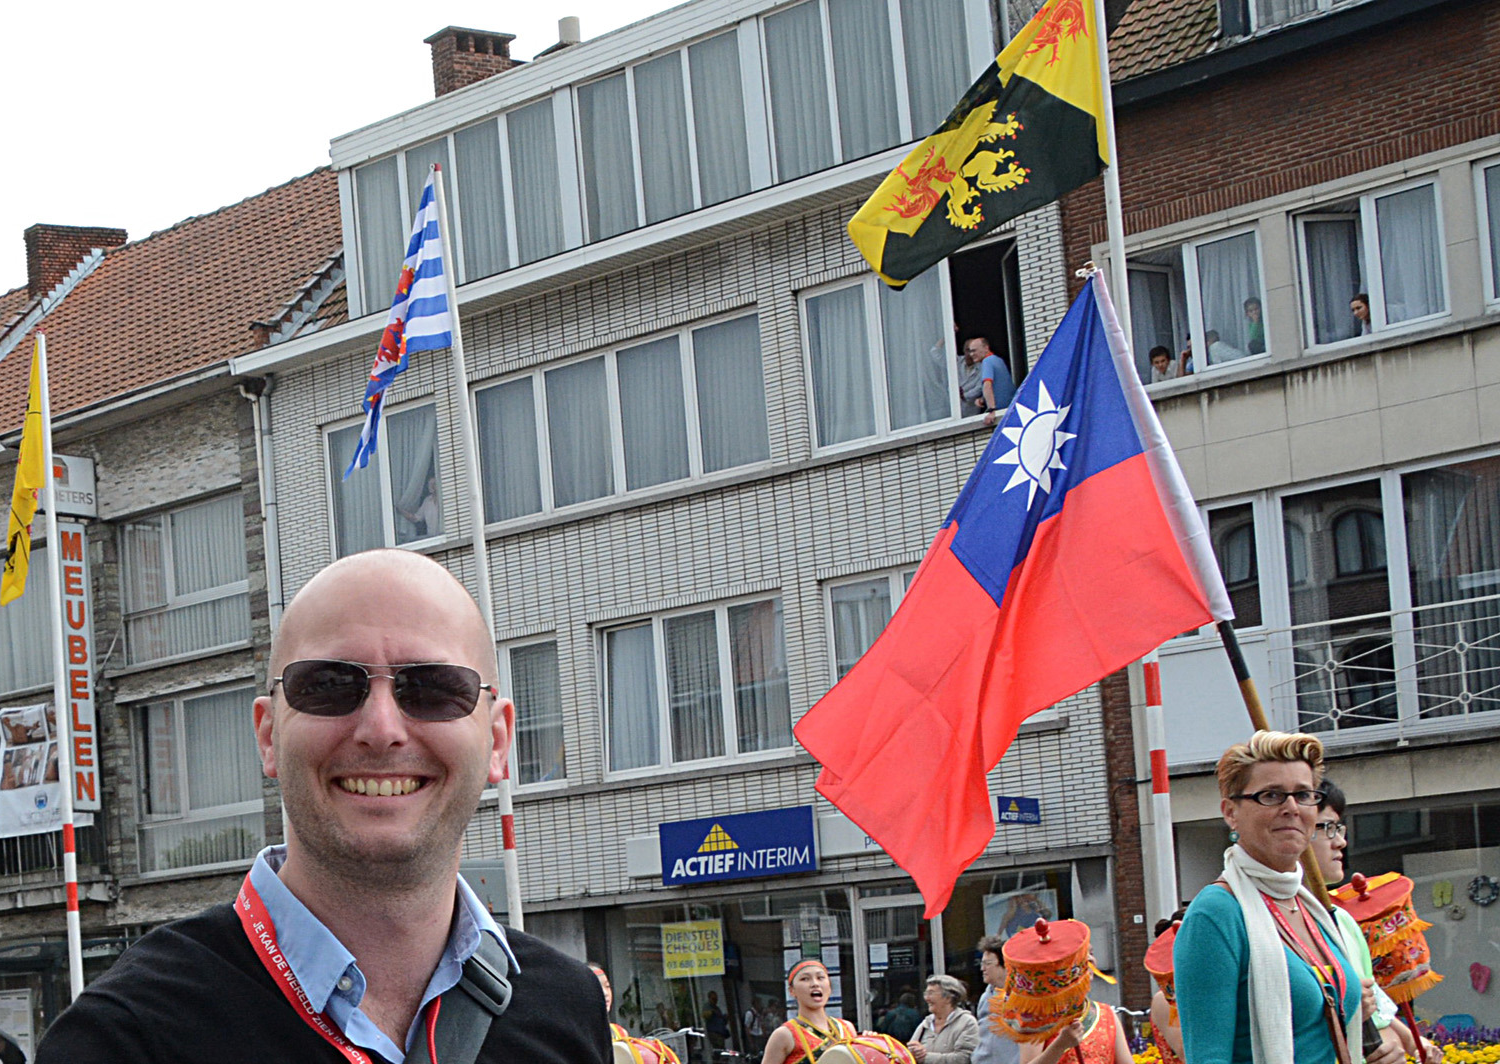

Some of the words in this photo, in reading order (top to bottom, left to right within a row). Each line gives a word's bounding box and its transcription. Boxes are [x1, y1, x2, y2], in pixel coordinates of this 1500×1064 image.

[60, 530, 97, 803] MEUBELEN
[671, 853, 735, 878] ACTIEF
[737, 845, 810, 871] INTERIM
[666, 928, 719, 943] DIENSTEN
[666, 940, 720, 955] CHEQUES
[252, 921, 265, 934] JE
[259, 931, 278, 955] KAN
[272, 954, 288, 971] DE
[283, 969, 315, 1015] WERELD
[312, 1015, 335, 1036] ZIEN
[333, 1034, 346, 1046] IN
